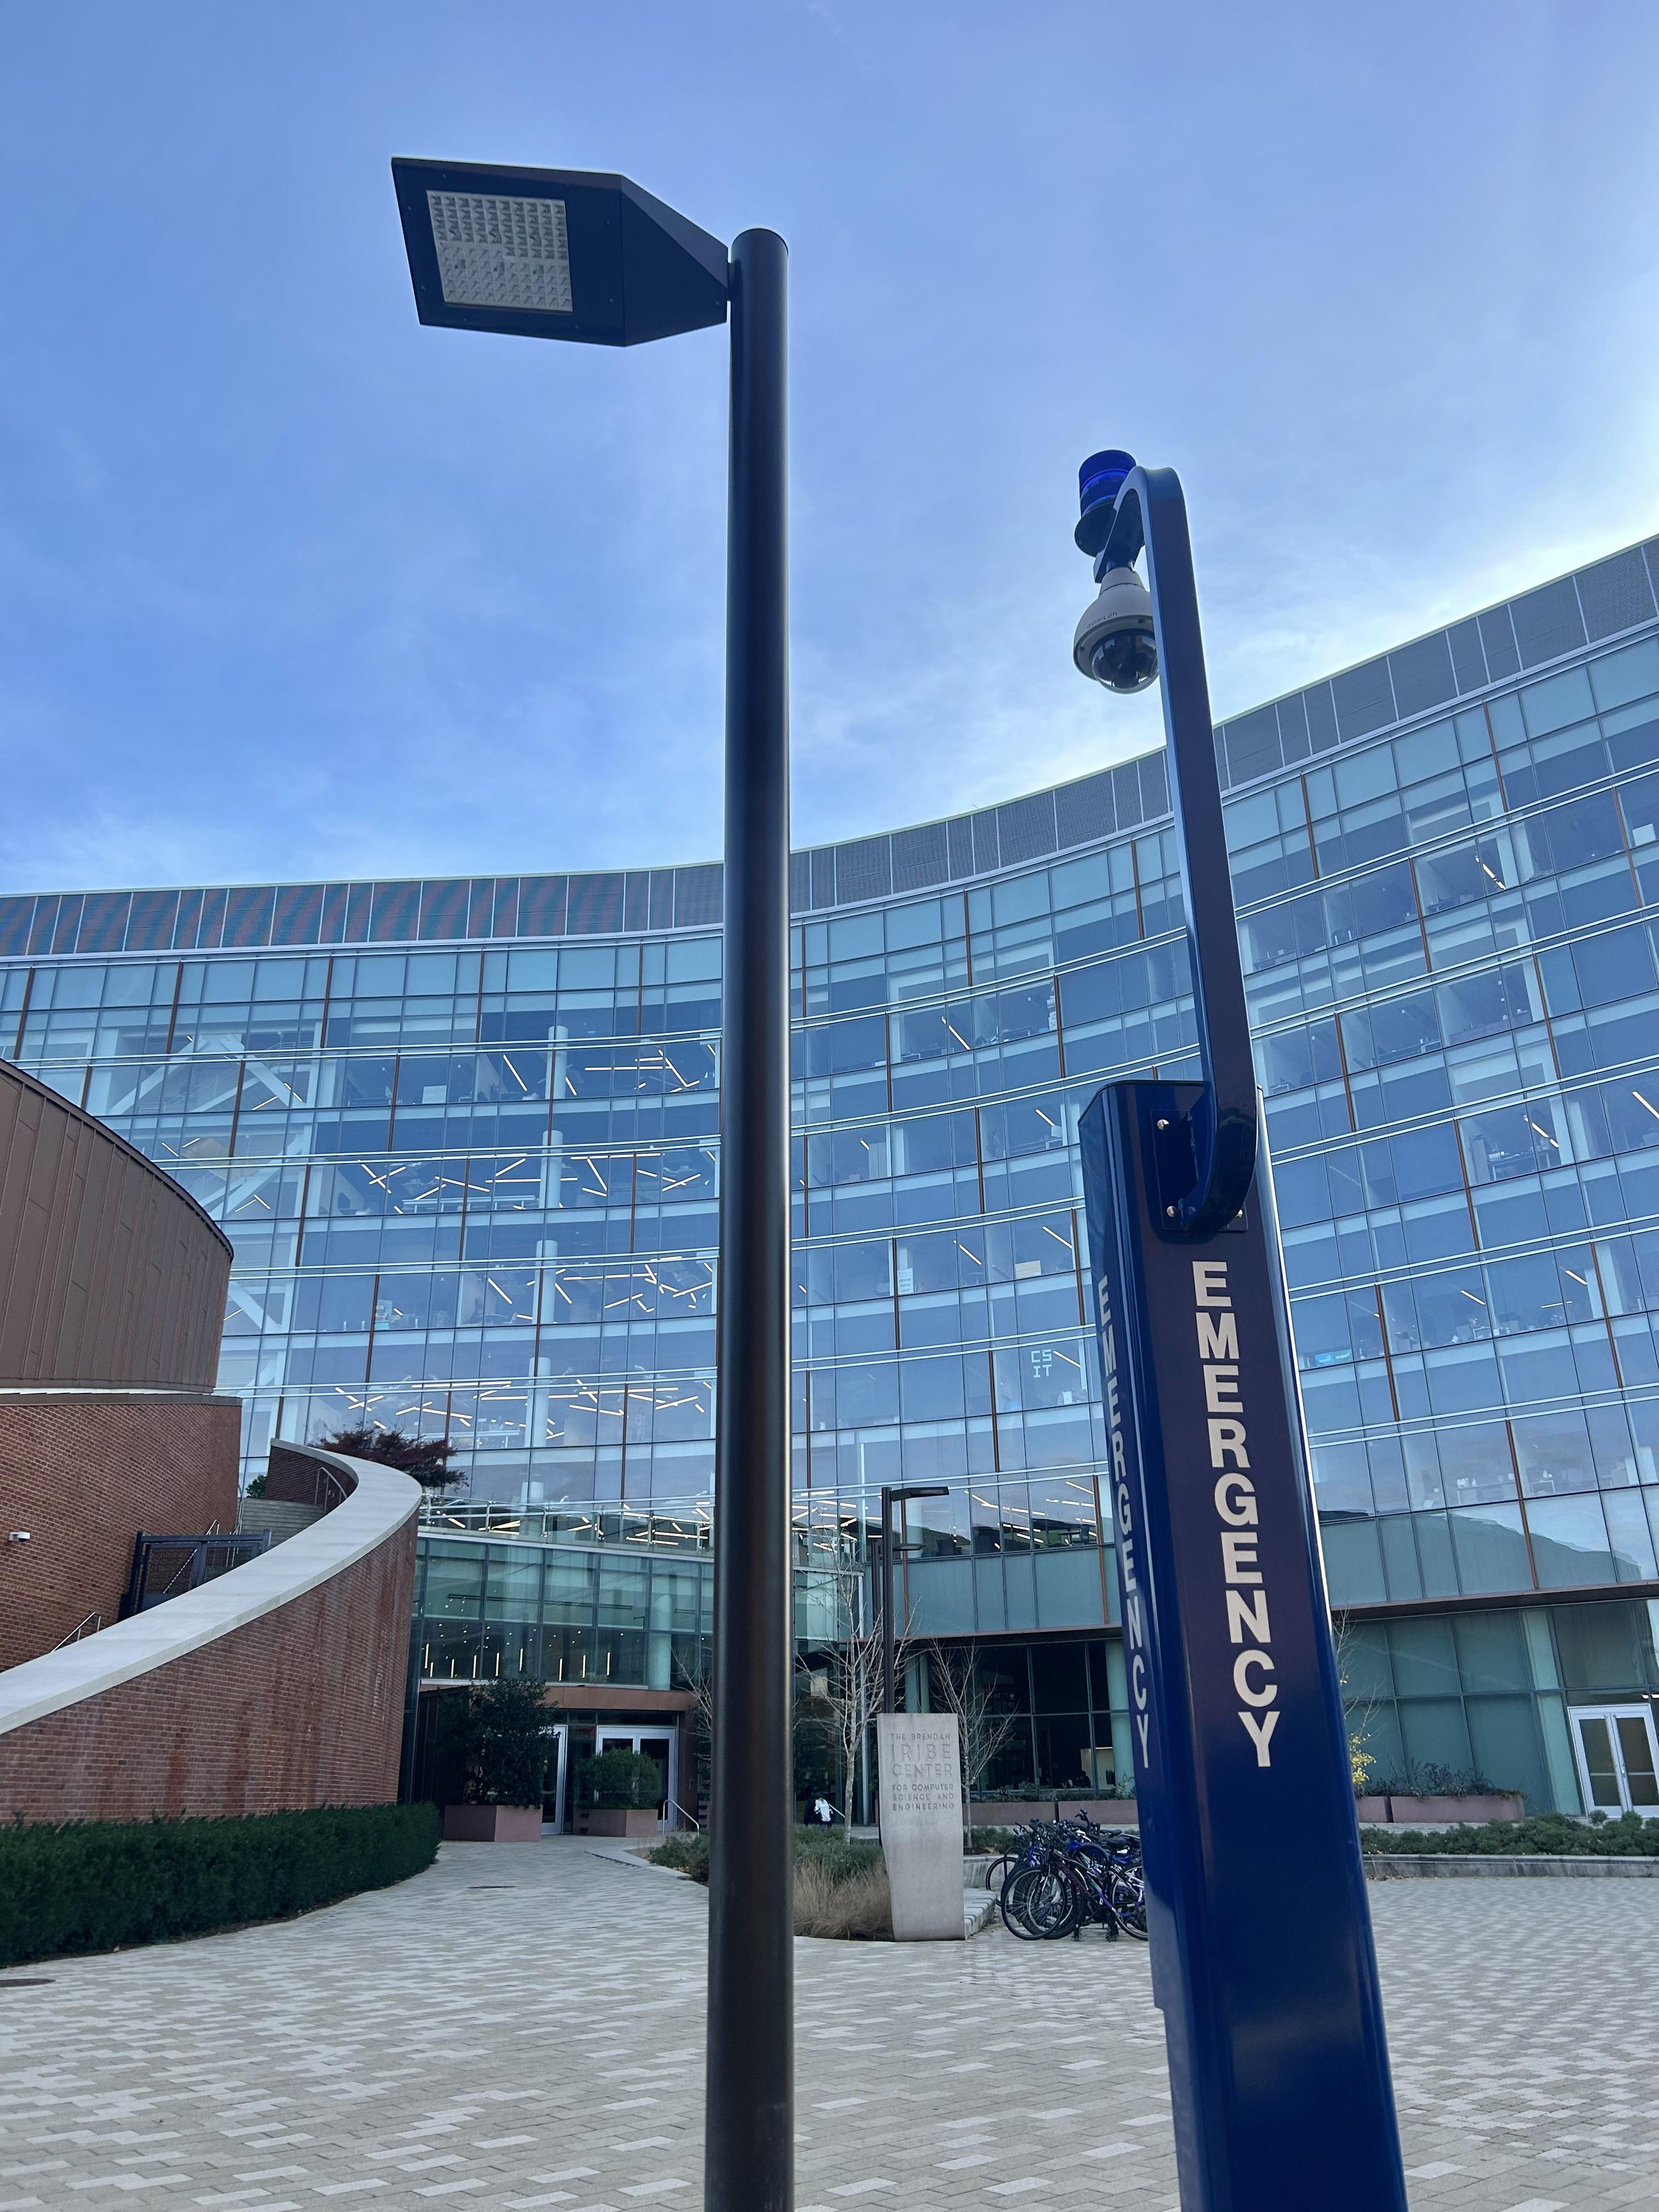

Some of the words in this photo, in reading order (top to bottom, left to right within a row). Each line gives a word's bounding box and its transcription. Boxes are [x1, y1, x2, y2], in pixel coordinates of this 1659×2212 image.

[1031, 1349, 1052, 1363] CS
[1034, 1364, 1052, 1378] IT
[1098, 1275, 1149, 1768] EMERGENCY
[1192, 1261, 1279, 1767] EMERGENCY
[891, 1744, 951, 1761] IRIBE
[892, 1764, 952, 1777] CENTER
